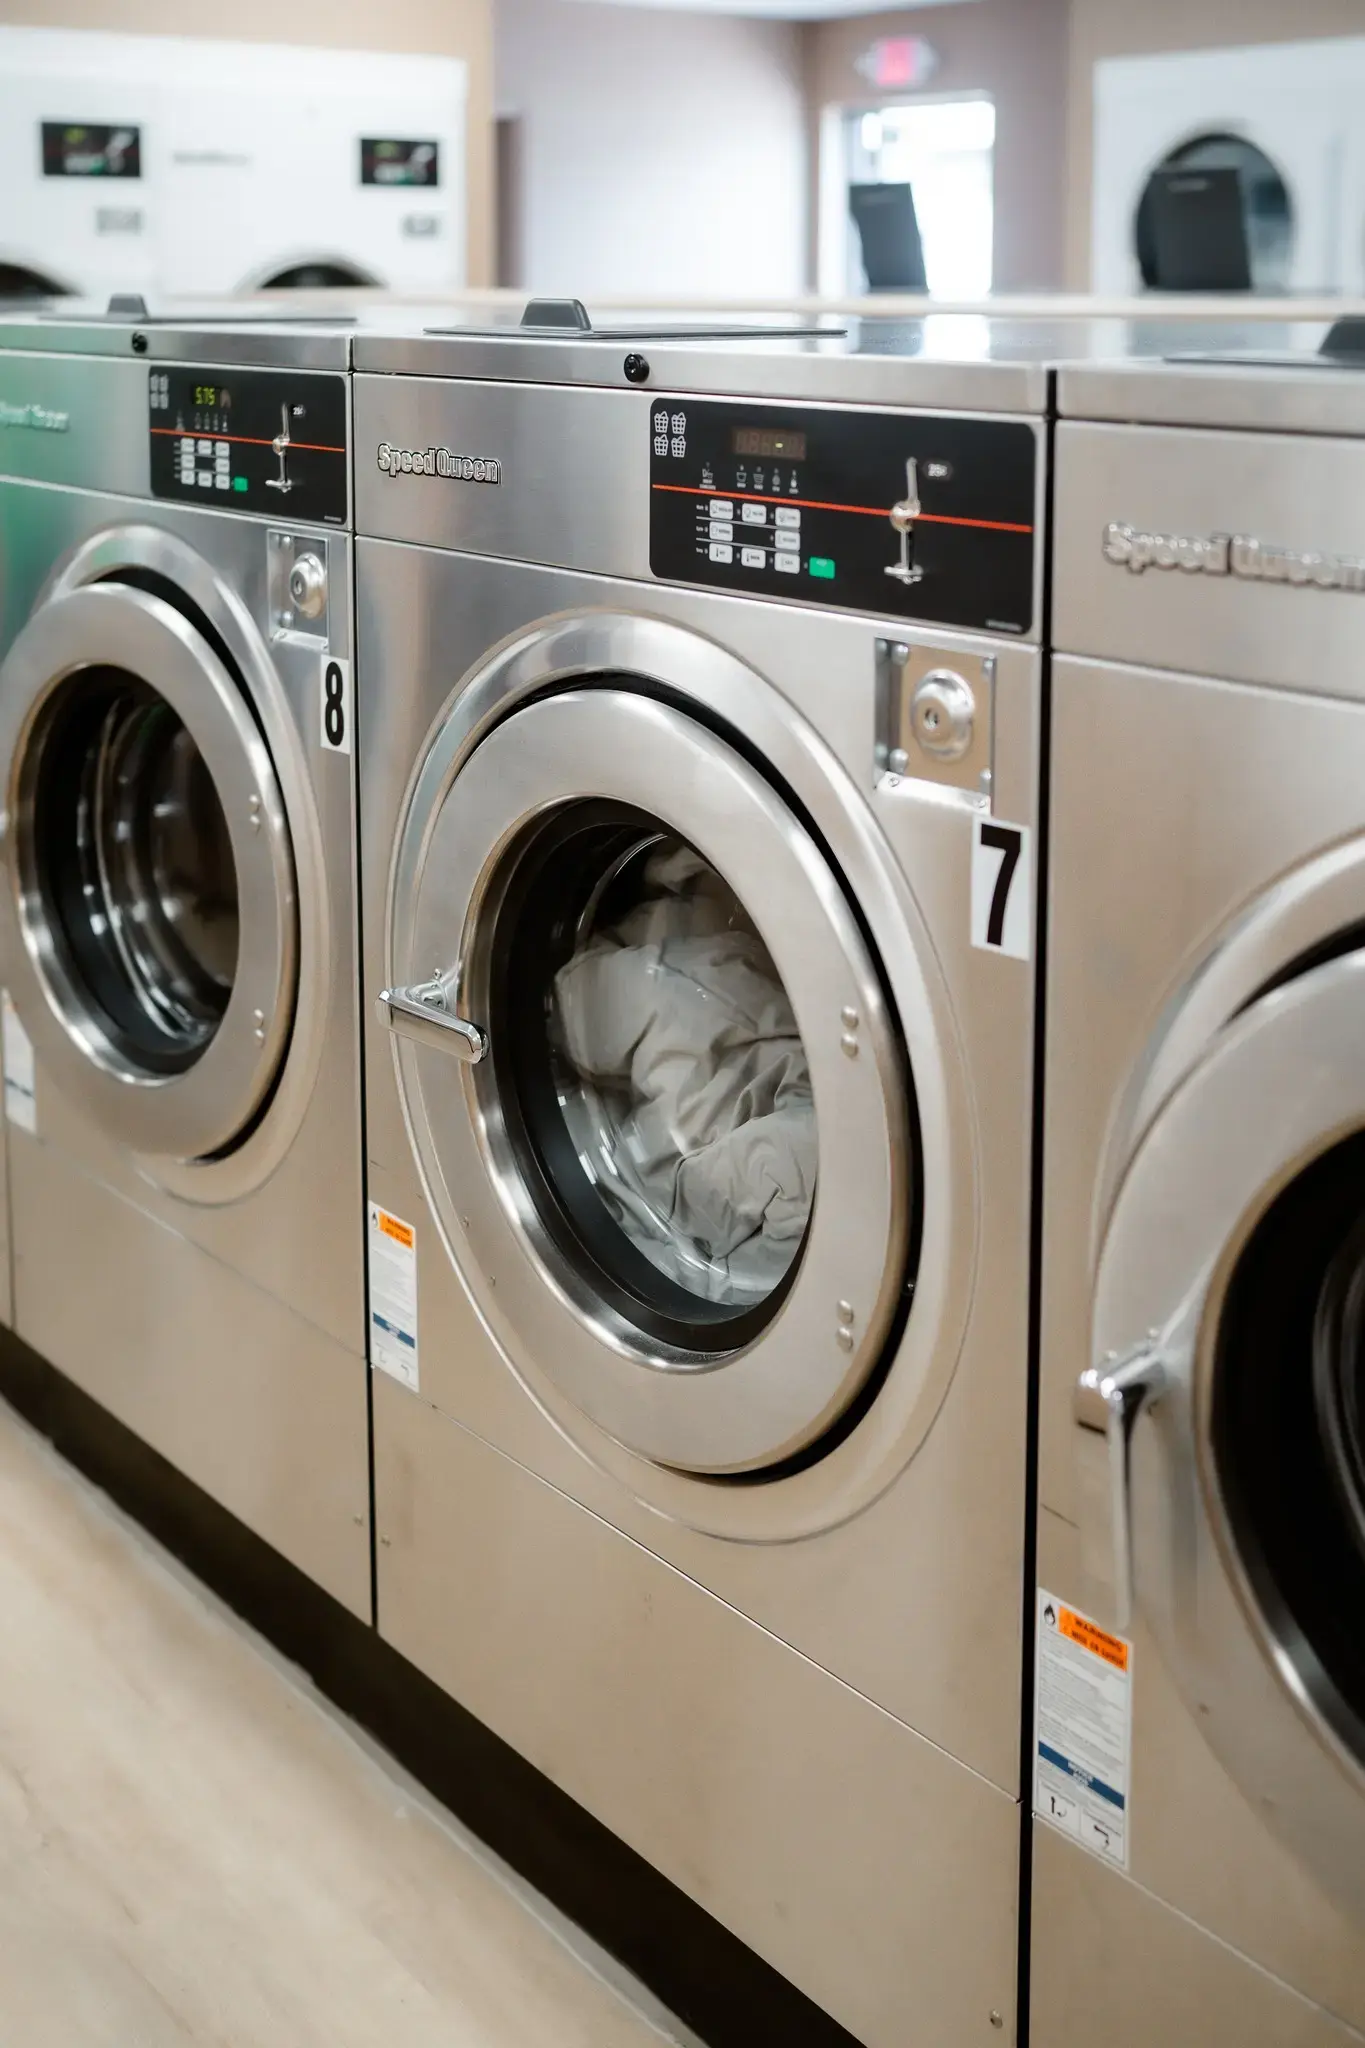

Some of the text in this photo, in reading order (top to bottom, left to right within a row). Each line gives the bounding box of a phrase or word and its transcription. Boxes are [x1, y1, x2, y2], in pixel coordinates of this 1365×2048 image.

[377, 442, 500, 484] Speed Queen
[1102, 521, 1229, 575] Speed
[325, 661, 344, 746] 8
[980, 823, 1021, 946] 7
